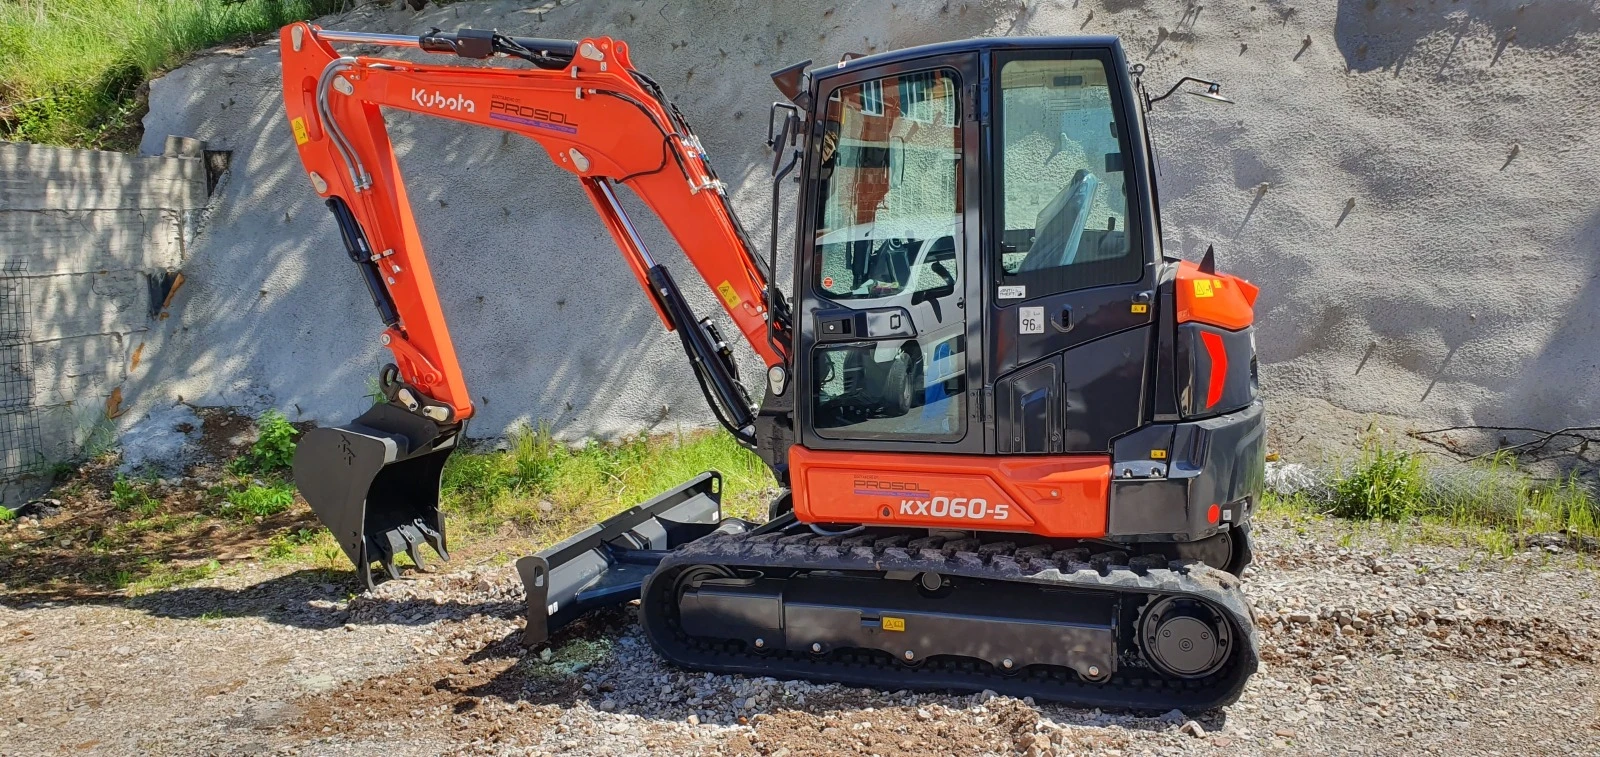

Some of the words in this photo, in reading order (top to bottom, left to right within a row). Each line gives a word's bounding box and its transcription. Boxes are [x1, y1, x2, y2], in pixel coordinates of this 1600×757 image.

[411, 87, 475, 113] Kubota
[490, 100, 578, 127] PROSOL
[1022, 318, 1036, 331] 96
[854, 480, 930, 491] PROSOL
[900, 496, 1009, 520] KX060-5
